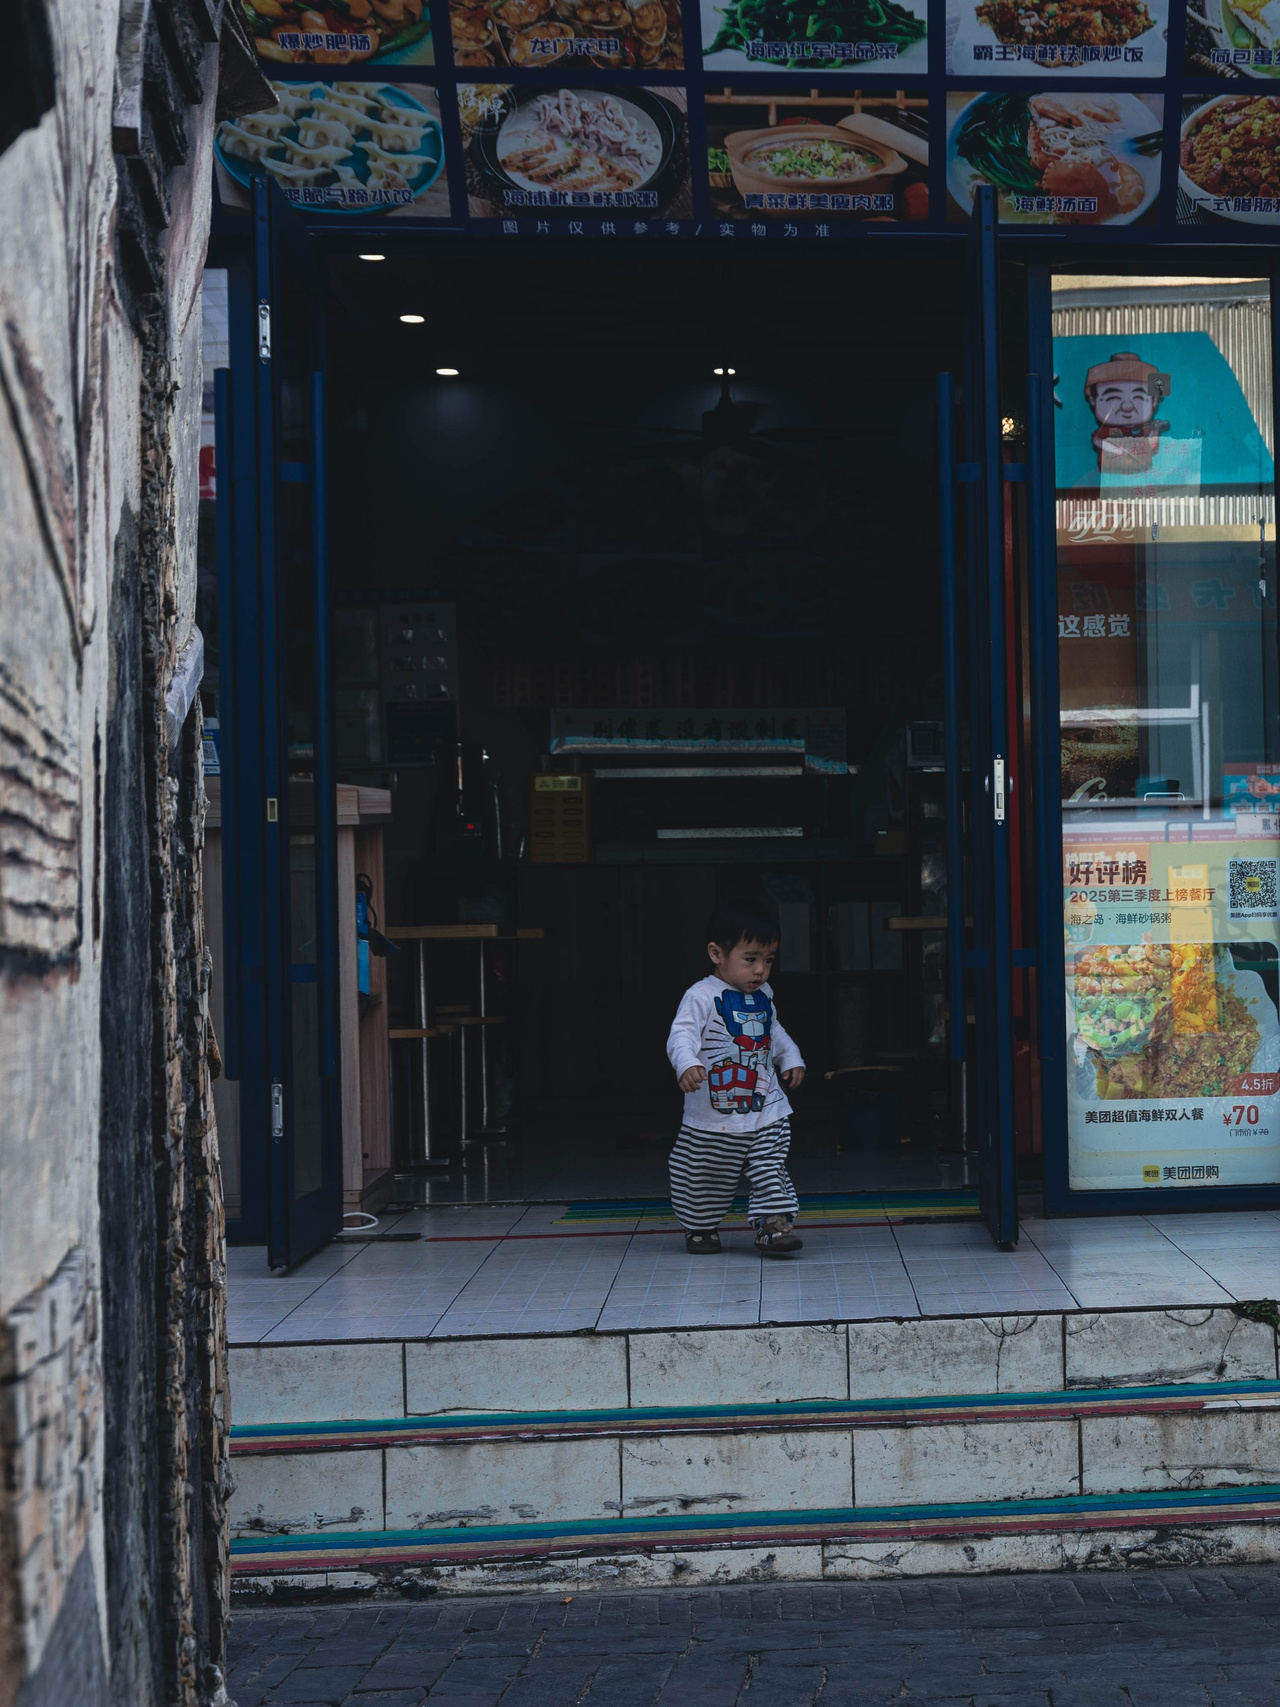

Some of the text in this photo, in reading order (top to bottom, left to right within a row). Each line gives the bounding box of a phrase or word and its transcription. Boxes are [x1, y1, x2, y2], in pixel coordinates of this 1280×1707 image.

[278, 32, 371, 52] 爆炒肥肠
[529, 37, 620, 56] 龙门花甲
[744, 41, 898, 60] 海南红军革命菜
[972, 44, 1144, 64] 霸王海鲜铁板炒饭
[503, 189, 658, 208] 海捕鱿鱼鲜虾粥
[744, 193, 895, 211] 青菜鲜美瘦肉粥
[1013, 194, 1098, 213] 海鲜汤面
[1058, 613, 1131, 638] 这感觉
[1070, 860, 1147, 886] 好评榜
[1070, 888, 1216, 903] 2025第三季度上榜餐厅
[1241, 1078, 1274, 1091] 4.5折
[1084, 1107, 1205, 1124] 美团超值海鲜双人餐
[1222, 1104, 1260, 1126] ¥70
[1144, 1169, 1160, 1178] 美团
[1162, 1165, 1220, 1180] 美团团购
